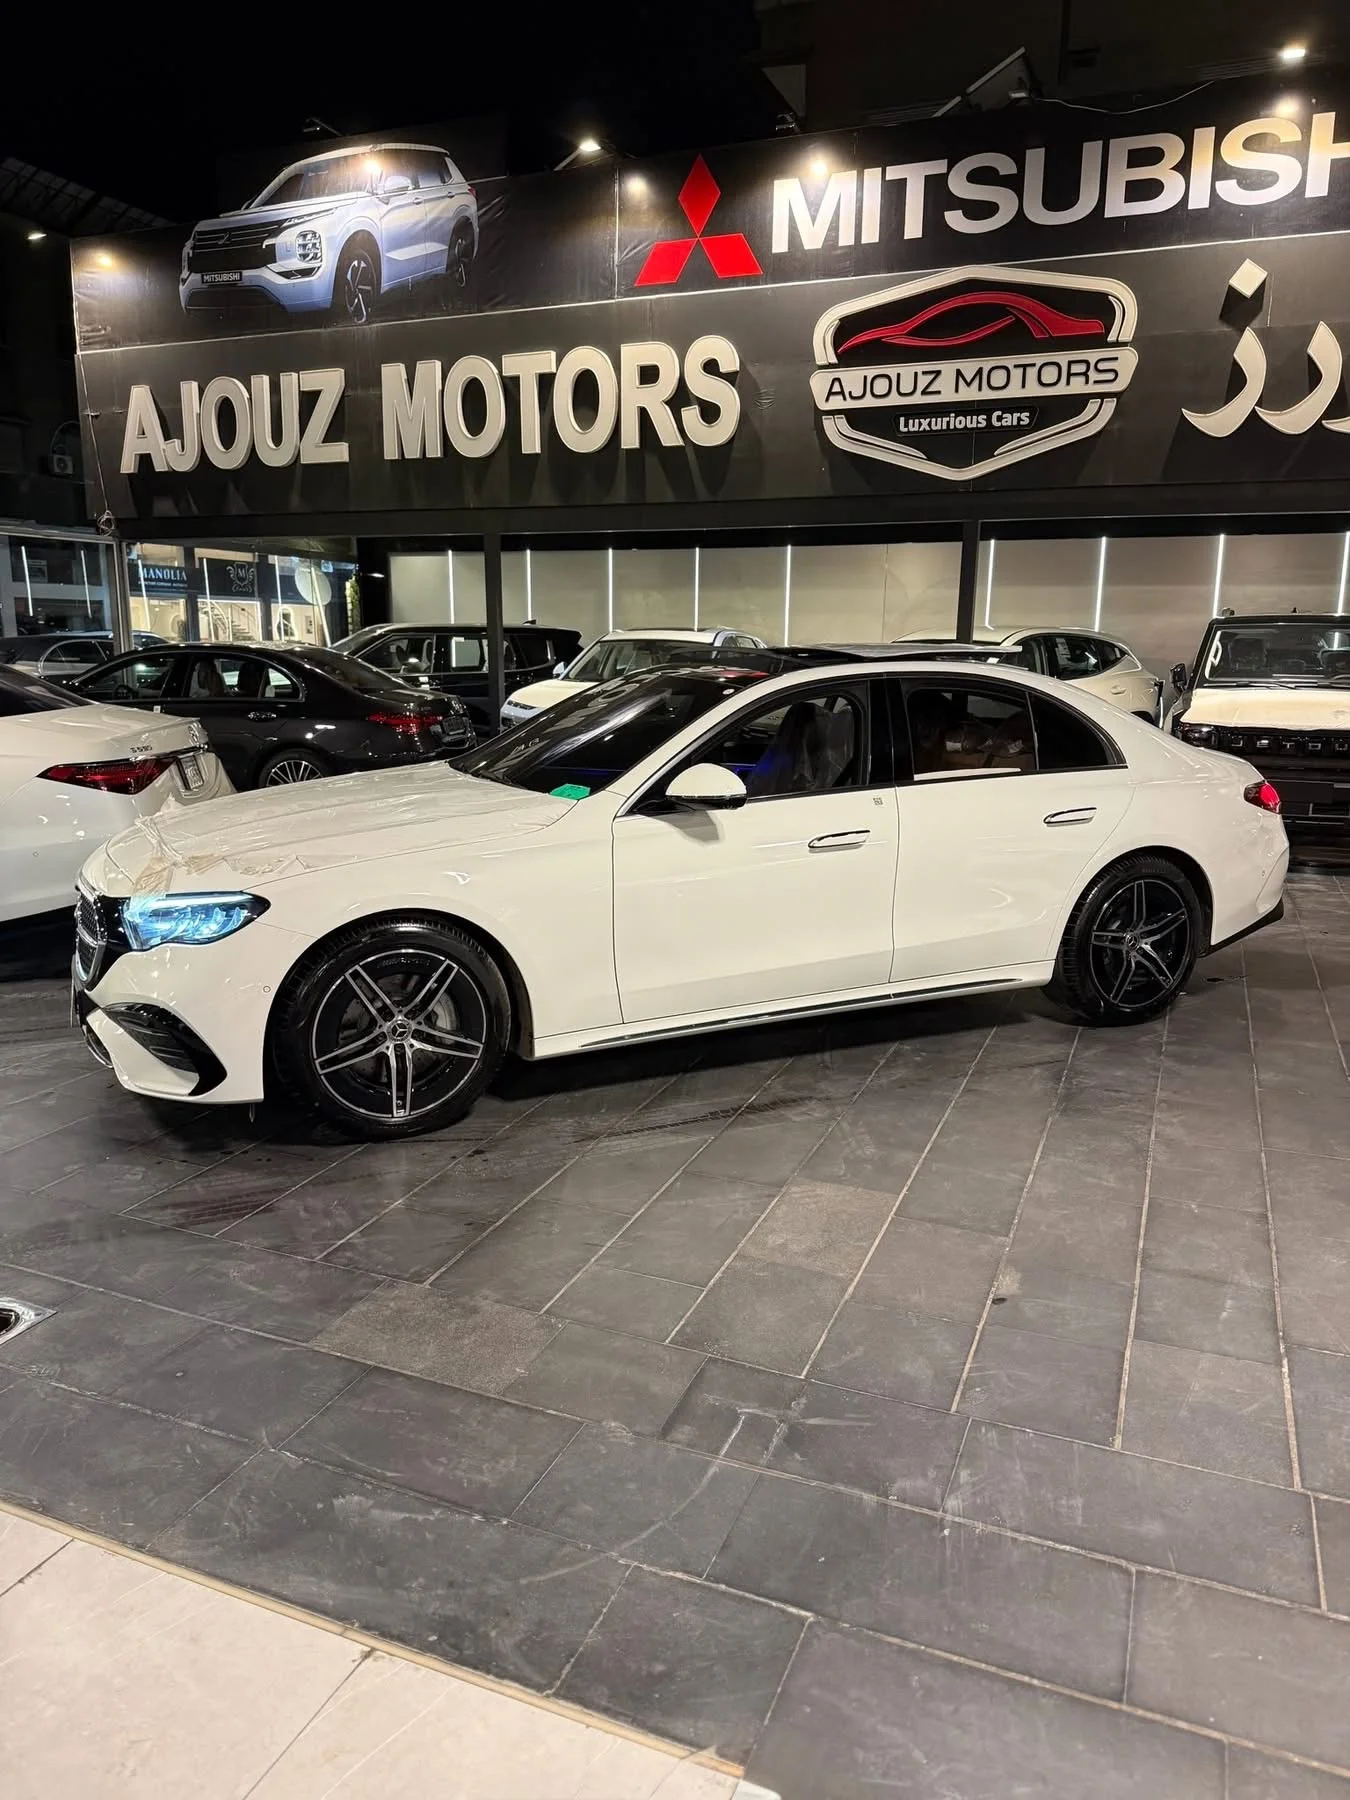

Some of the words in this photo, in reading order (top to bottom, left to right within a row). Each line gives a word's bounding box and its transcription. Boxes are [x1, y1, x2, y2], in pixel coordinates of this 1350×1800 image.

[203, 272, 240, 282] MITSUBISHI
[825, 370, 942, 403] AJOUZ
[954, 356, 1119, 393] MOTORS
[119, 368, 349, 474] AJOUZ
[381, 335, 741, 461] MOTORS
[899, 412, 987, 432] Luxurious
[991, 410, 1030, 427] Cars
[138, 567, 188, 580] MANOLIA
